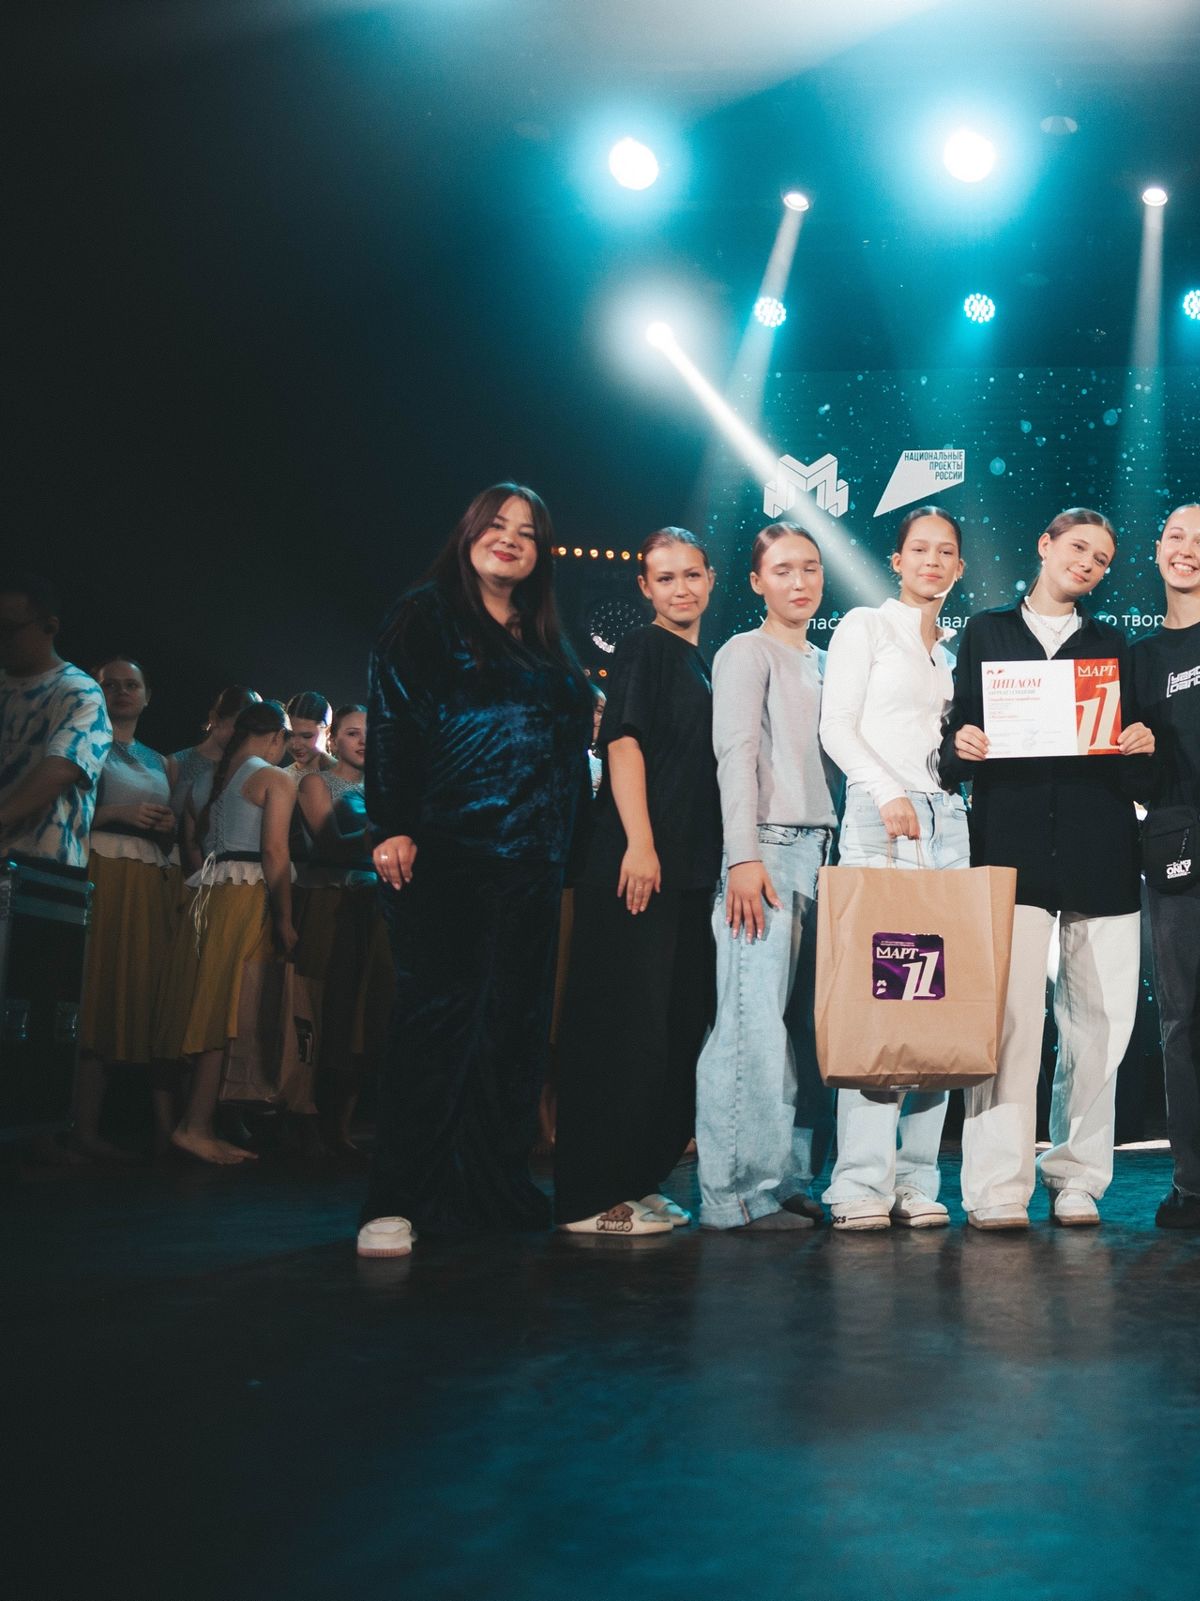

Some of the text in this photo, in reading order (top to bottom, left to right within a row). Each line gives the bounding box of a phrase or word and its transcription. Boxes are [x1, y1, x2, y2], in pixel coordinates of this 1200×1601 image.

[904, 451, 964, 461] НАЦИОНАЛЬНЫЕ
[929, 461, 963, 470] ПРОЕКТЫ
[934, 471, 963, 480] РОССИИ
[1078, 665, 1116, 677] МАРТ
[876, 946, 919, 960] МАРТ
